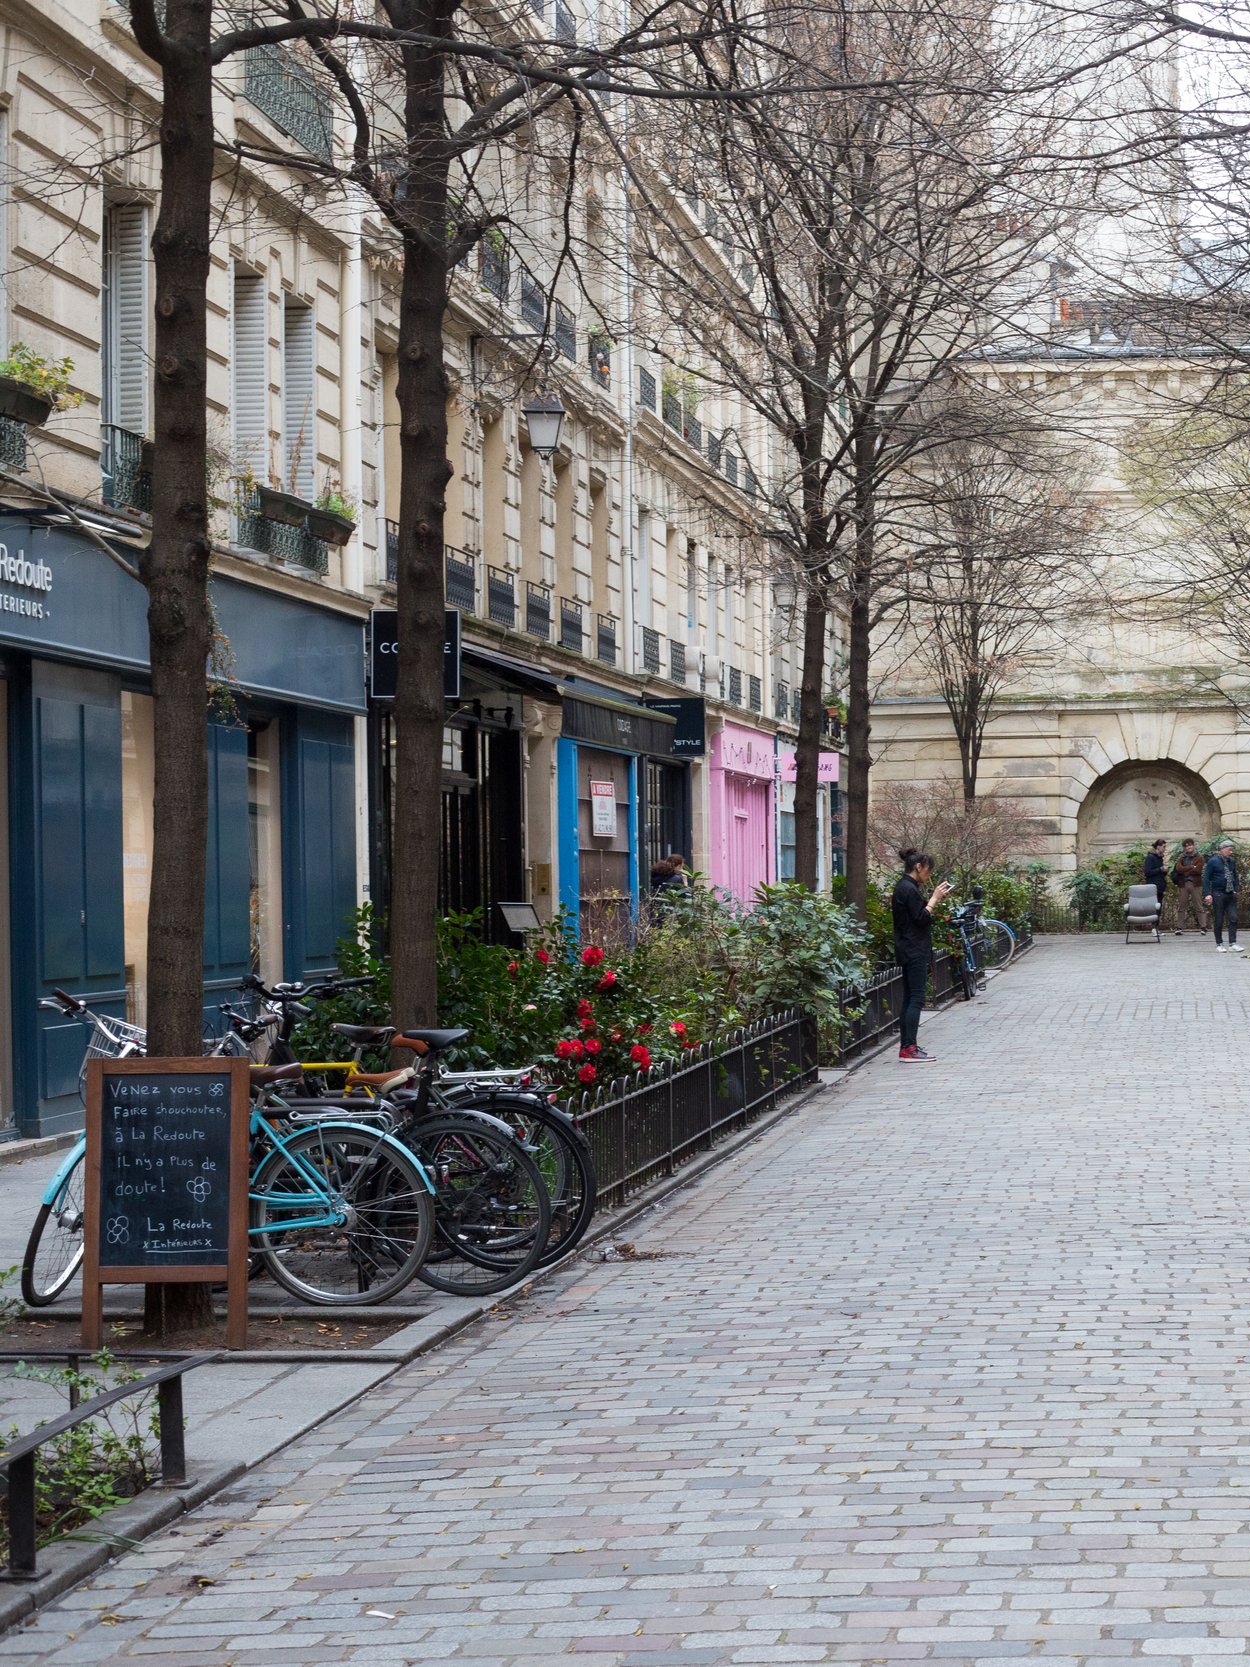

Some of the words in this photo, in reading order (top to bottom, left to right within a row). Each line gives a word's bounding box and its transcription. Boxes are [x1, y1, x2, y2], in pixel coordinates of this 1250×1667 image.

[0, 543, 53, 591] Redoute
[169, 1086, 202, 1095] vous
[131, 1127, 145, 1140] La
[153, 1125, 206, 1141] Redoute
[155, 1158, 164, 1167] a
[201, 1156, 217, 1171] de
[115, 1176, 166, 1196] doute!
[147, 1217, 165, 1232] La
[172, 1218, 213, 1231] Redoute
